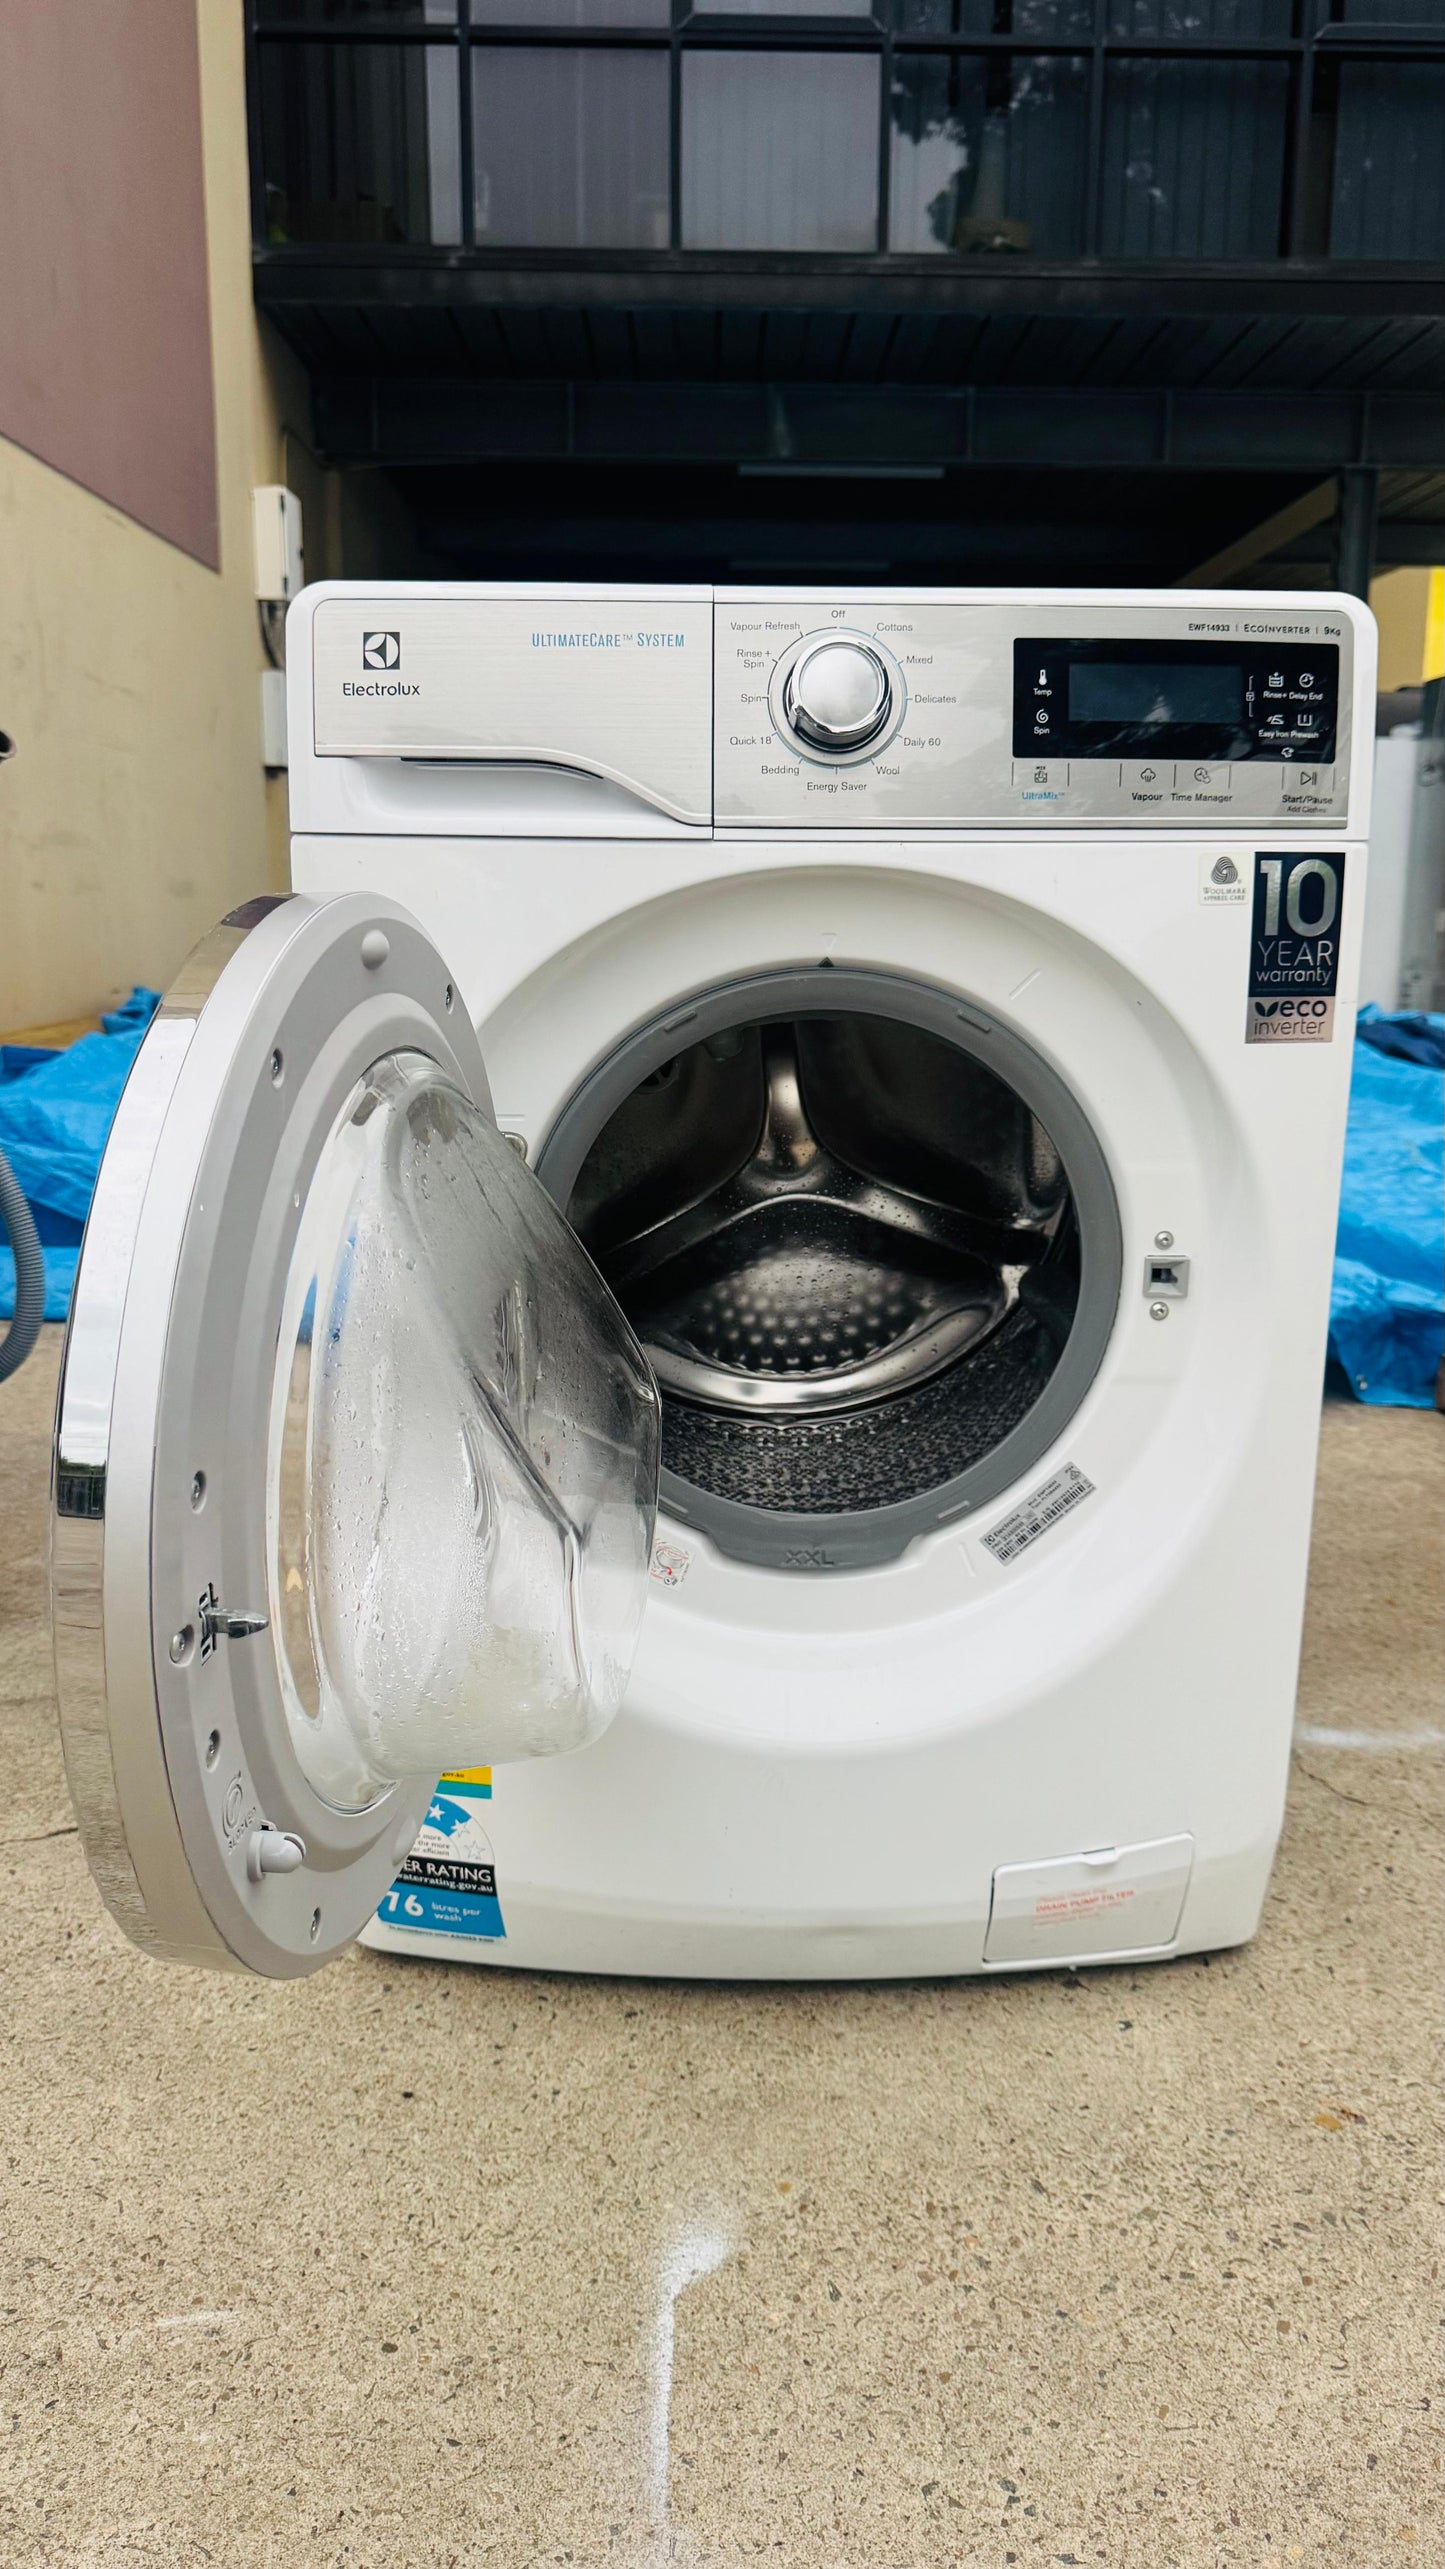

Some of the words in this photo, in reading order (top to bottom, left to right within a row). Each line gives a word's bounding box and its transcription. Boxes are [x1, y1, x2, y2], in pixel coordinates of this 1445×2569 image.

[831, 610, 846, 619] Off
[730, 622, 762, 632] Vapour
[765, 622, 801, 631] Refresh
[876, 622, 913, 632] Cottons
[1188, 623, 1230, 632] EWF14933
[637, 632, 686, 648] SYSTEM
[736, 649, 764, 658] Rinse
[743, 660, 765, 670] Spin
[906, 655, 933, 665] Mixed
[342, 682, 421, 697] Electrolux
[1033, 688, 1053, 697] Temp
[740, 694, 763, 704] Spin
[914, 694, 957, 704] Delicates
[1263, 690, 1287, 699] Rinse+
[1289, 691, 1308, 701] Delay
[1309, 692, 1324, 700] End
[1033, 726, 1050, 736] Spin
[1258, 730, 1275, 739] Easy
[1276, 730, 1290, 738] Iron
[730, 736, 758, 746] Quick
[760, 736, 772, 745] 18
[903, 737, 926, 748] Daily
[928, 738, 941, 746] 60
[761, 766, 800, 776] Bedding
[876, 766, 900, 776] Wool
[806, 782, 839, 793] Energy
[841, 782, 867, 791] Saver
[1131, 792, 1163, 802] Vapour
[1171, 793, 1193, 802] Time
[1195, 793, 1233, 804] Manager
[1281, 794, 1334, 805] Start/Pause
[1260, 858, 1338, 938] 10
[1258, 940, 1334, 966] YEAR
[1256, 966, 1332, 986] warranty
[1279, 1000, 1327, 1017] eco
[1254, 1018, 1326, 1035] inverter
[784, 1549, 835, 1566] XXL
[426, 1862, 492, 1883] RATING
[432, 1901, 460, 1914] litres
[462, 1908, 481, 1916] per
[434, 1912, 462, 1922] wash
